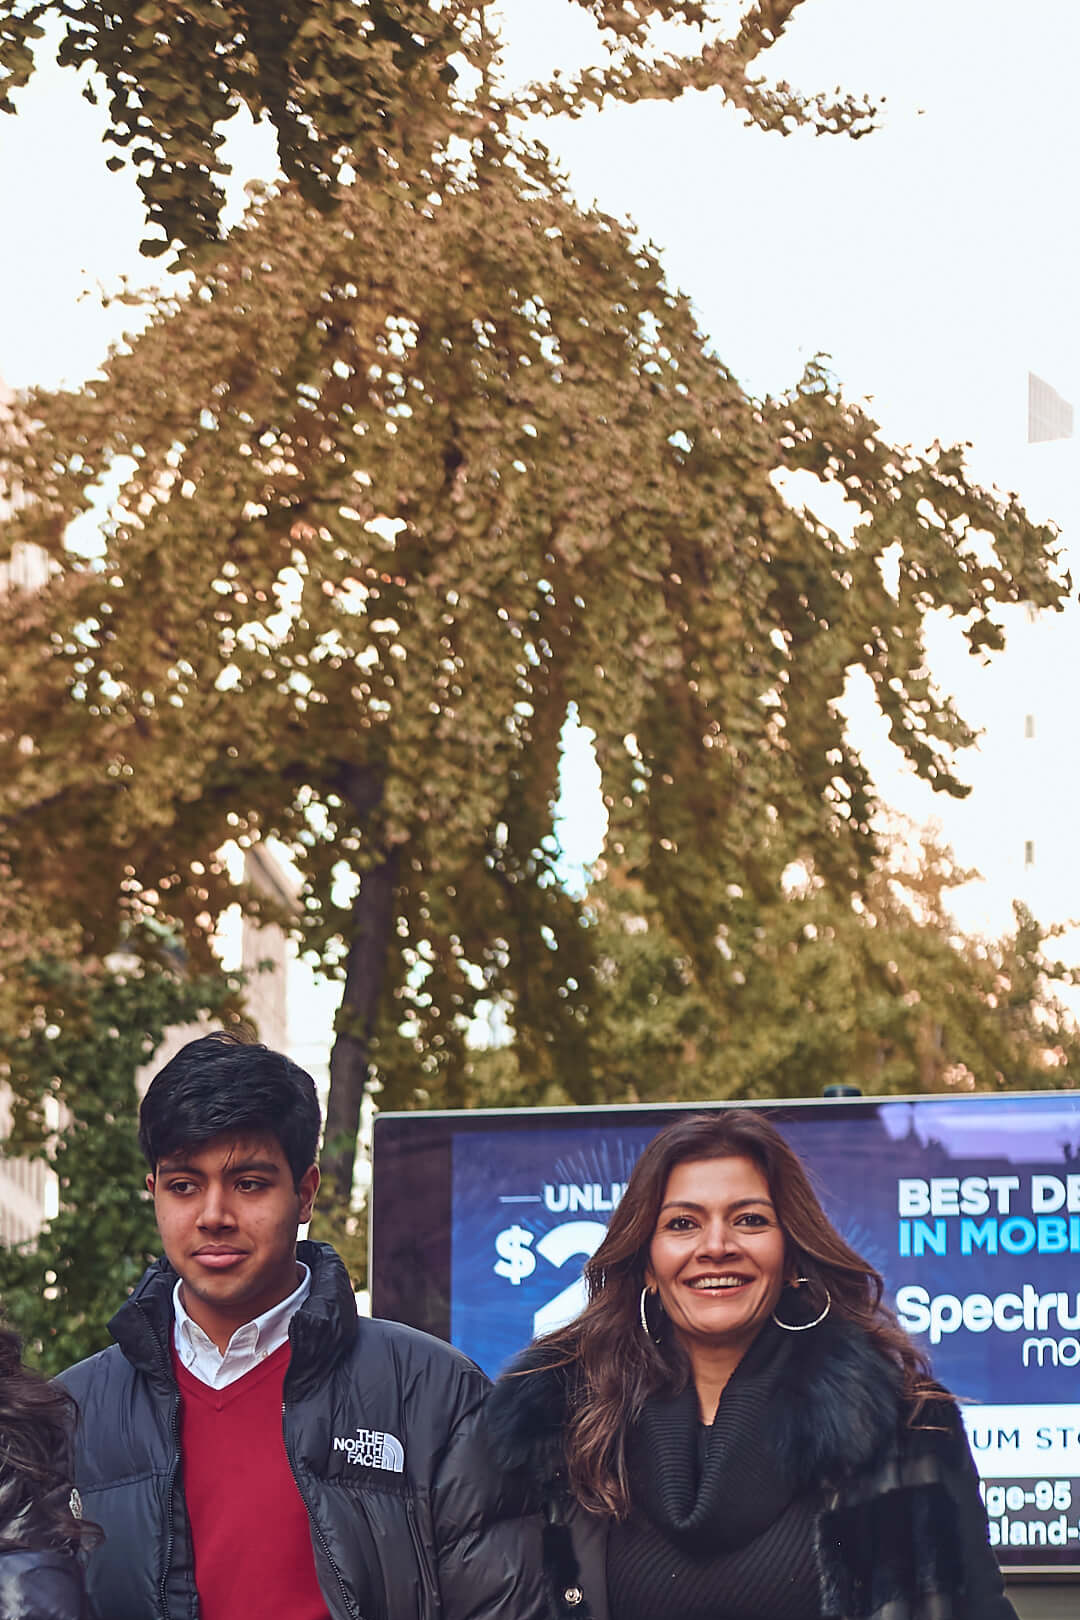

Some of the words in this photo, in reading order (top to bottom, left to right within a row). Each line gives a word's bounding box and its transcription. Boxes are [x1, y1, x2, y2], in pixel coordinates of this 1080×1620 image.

[898, 1176, 1020, 1217] BEST
[899, 1218, 947, 1257] IN
[960, 1215, 1080, 1255] MOBI
[895, 1283, 1080, 1344] Spectru
[1022, 1336, 1080, 1368] mo
[333, 1437, 383, 1458] NORTH
[356, 1428, 385, 1446] THE
[972, 1427, 1020, 1450] UM
[1036, 1427, 1080, 1450] ST
[347, 1451, 383, 1469] FACE
